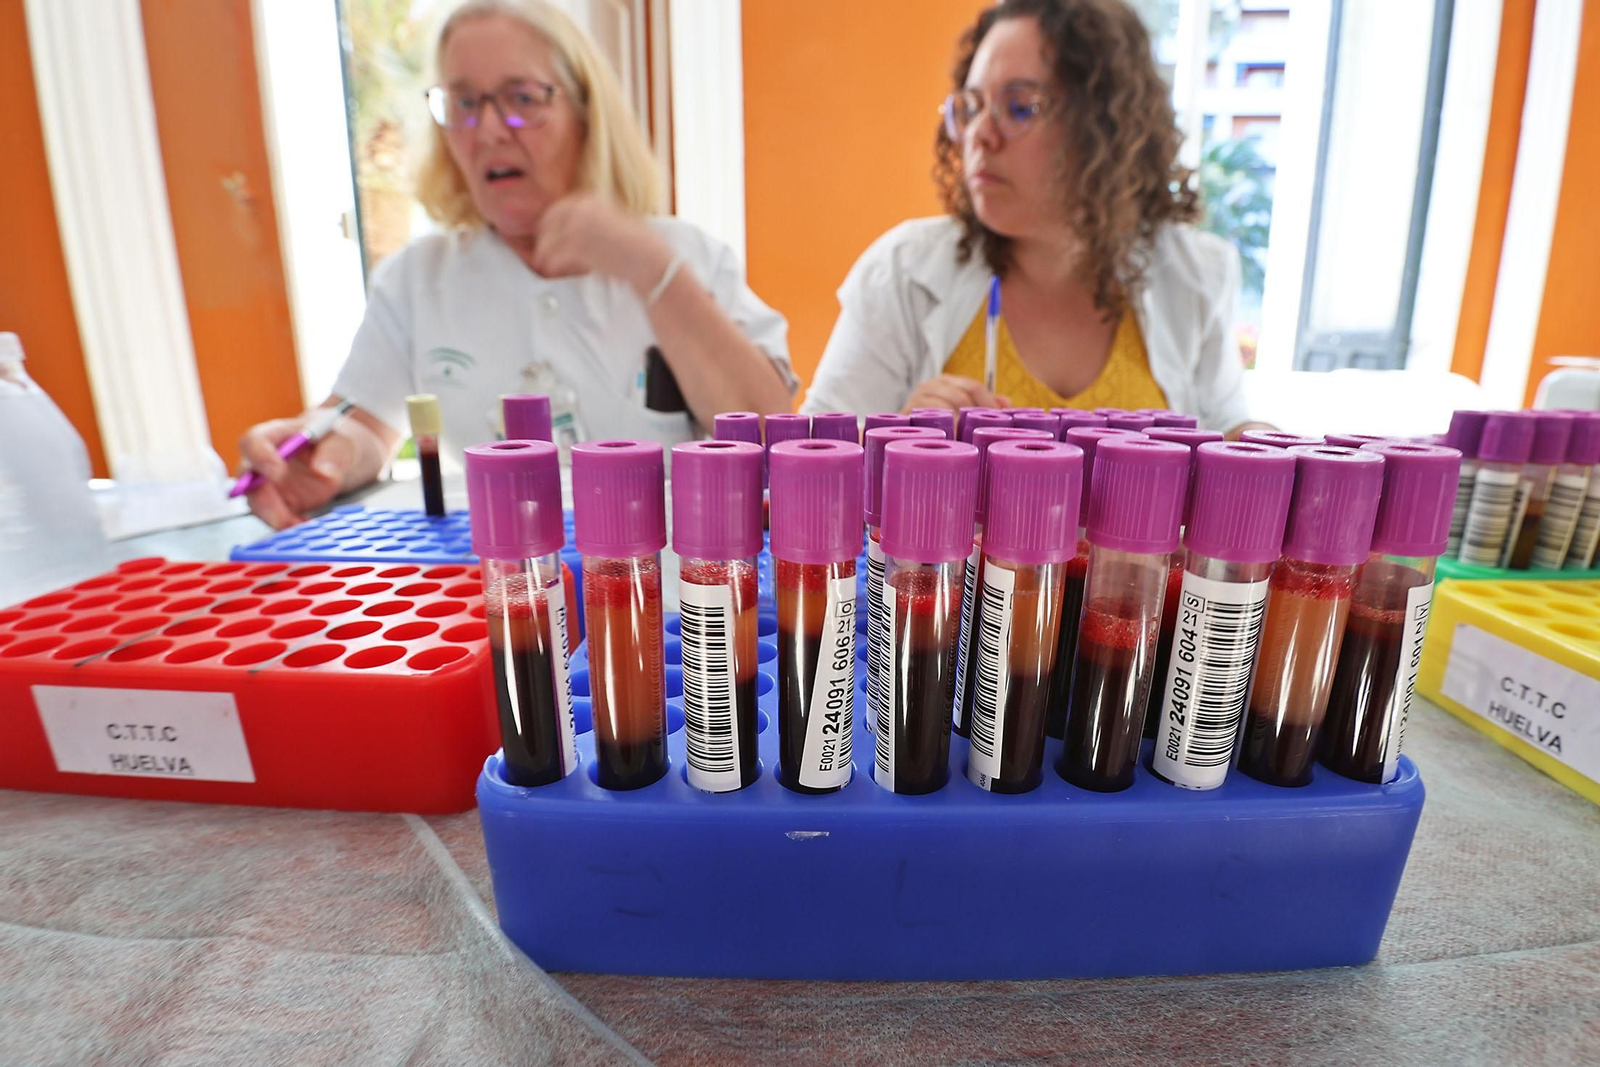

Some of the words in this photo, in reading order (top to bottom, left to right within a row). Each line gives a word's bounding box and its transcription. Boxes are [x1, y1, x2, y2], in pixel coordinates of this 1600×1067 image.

[1183, 610, 1198, 627] 21
[1187, 596, 1200, 607] S
[836, 619, 851, 633] 21
[832, 636, 851, 671] 606
[1179, 627, 1198, 663] 604
[822, 678, 846, 735] 24091
[1170, 666, 1193, 727] 24091
[1500, 677, 1567, 719] C.T.T.C
[105, 723, 179, 742] C.T.T.C
[1166, 726, 1182, 762] E0021
[1488, 700, 1562, 753] HUELVA
[109, 753, 195, 774] HUELVA
[819, 738, 837, 772] E0021
